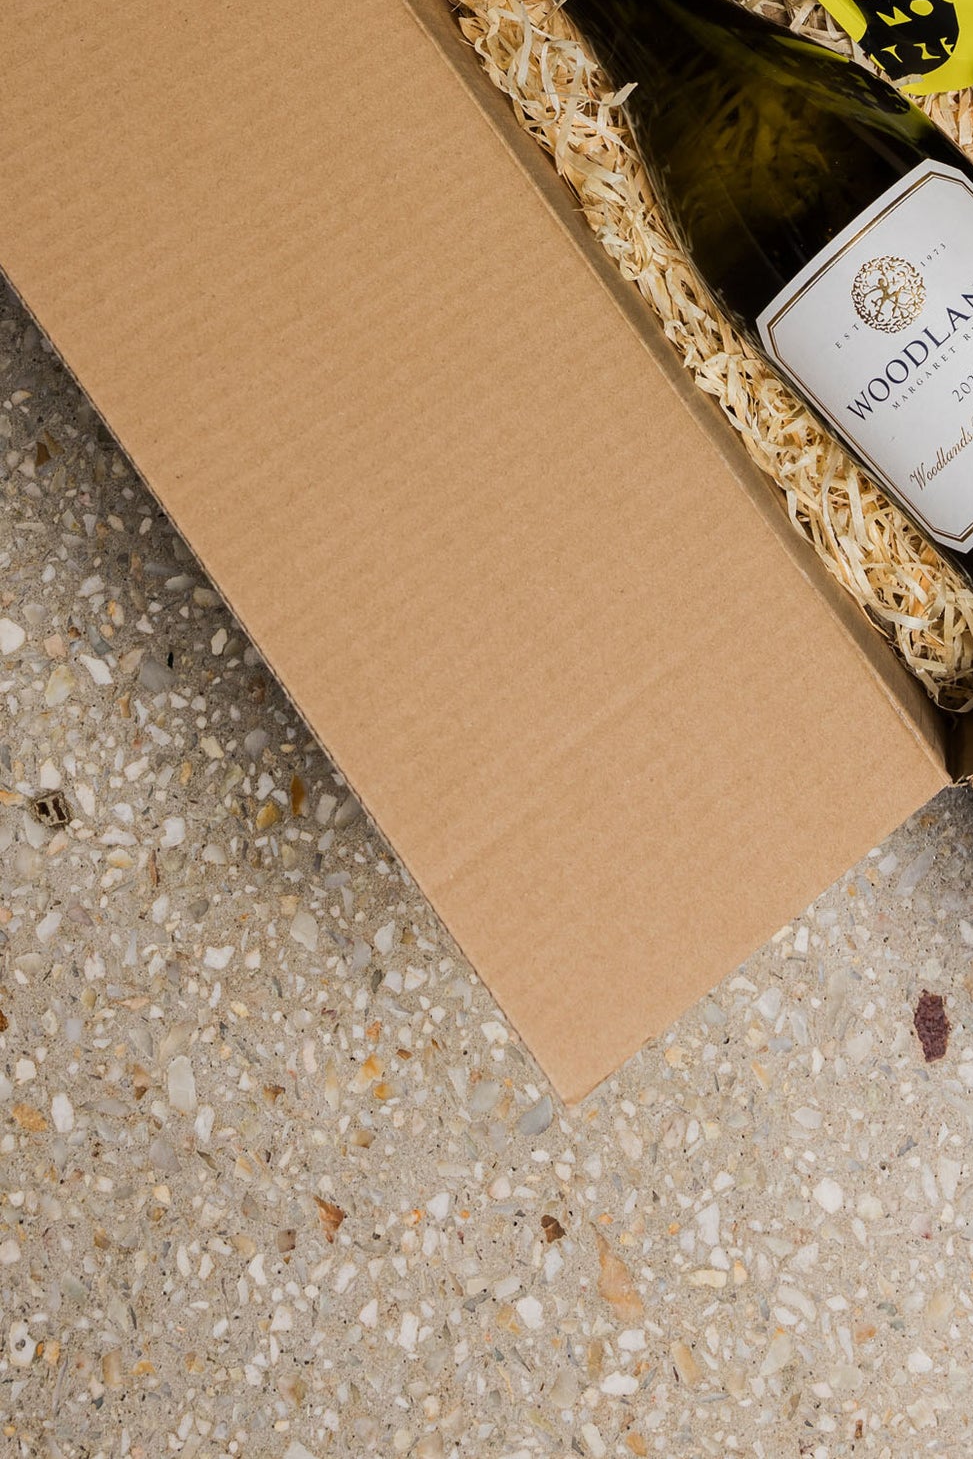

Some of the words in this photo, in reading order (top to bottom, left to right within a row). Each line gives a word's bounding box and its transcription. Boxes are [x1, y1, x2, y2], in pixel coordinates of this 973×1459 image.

[834, 322, 861, 350] EST
[919, 242, 947, 268] 1973
[891, 345, 957, 411] MARGARET
[908, 425, 973, 492] Woodlands
